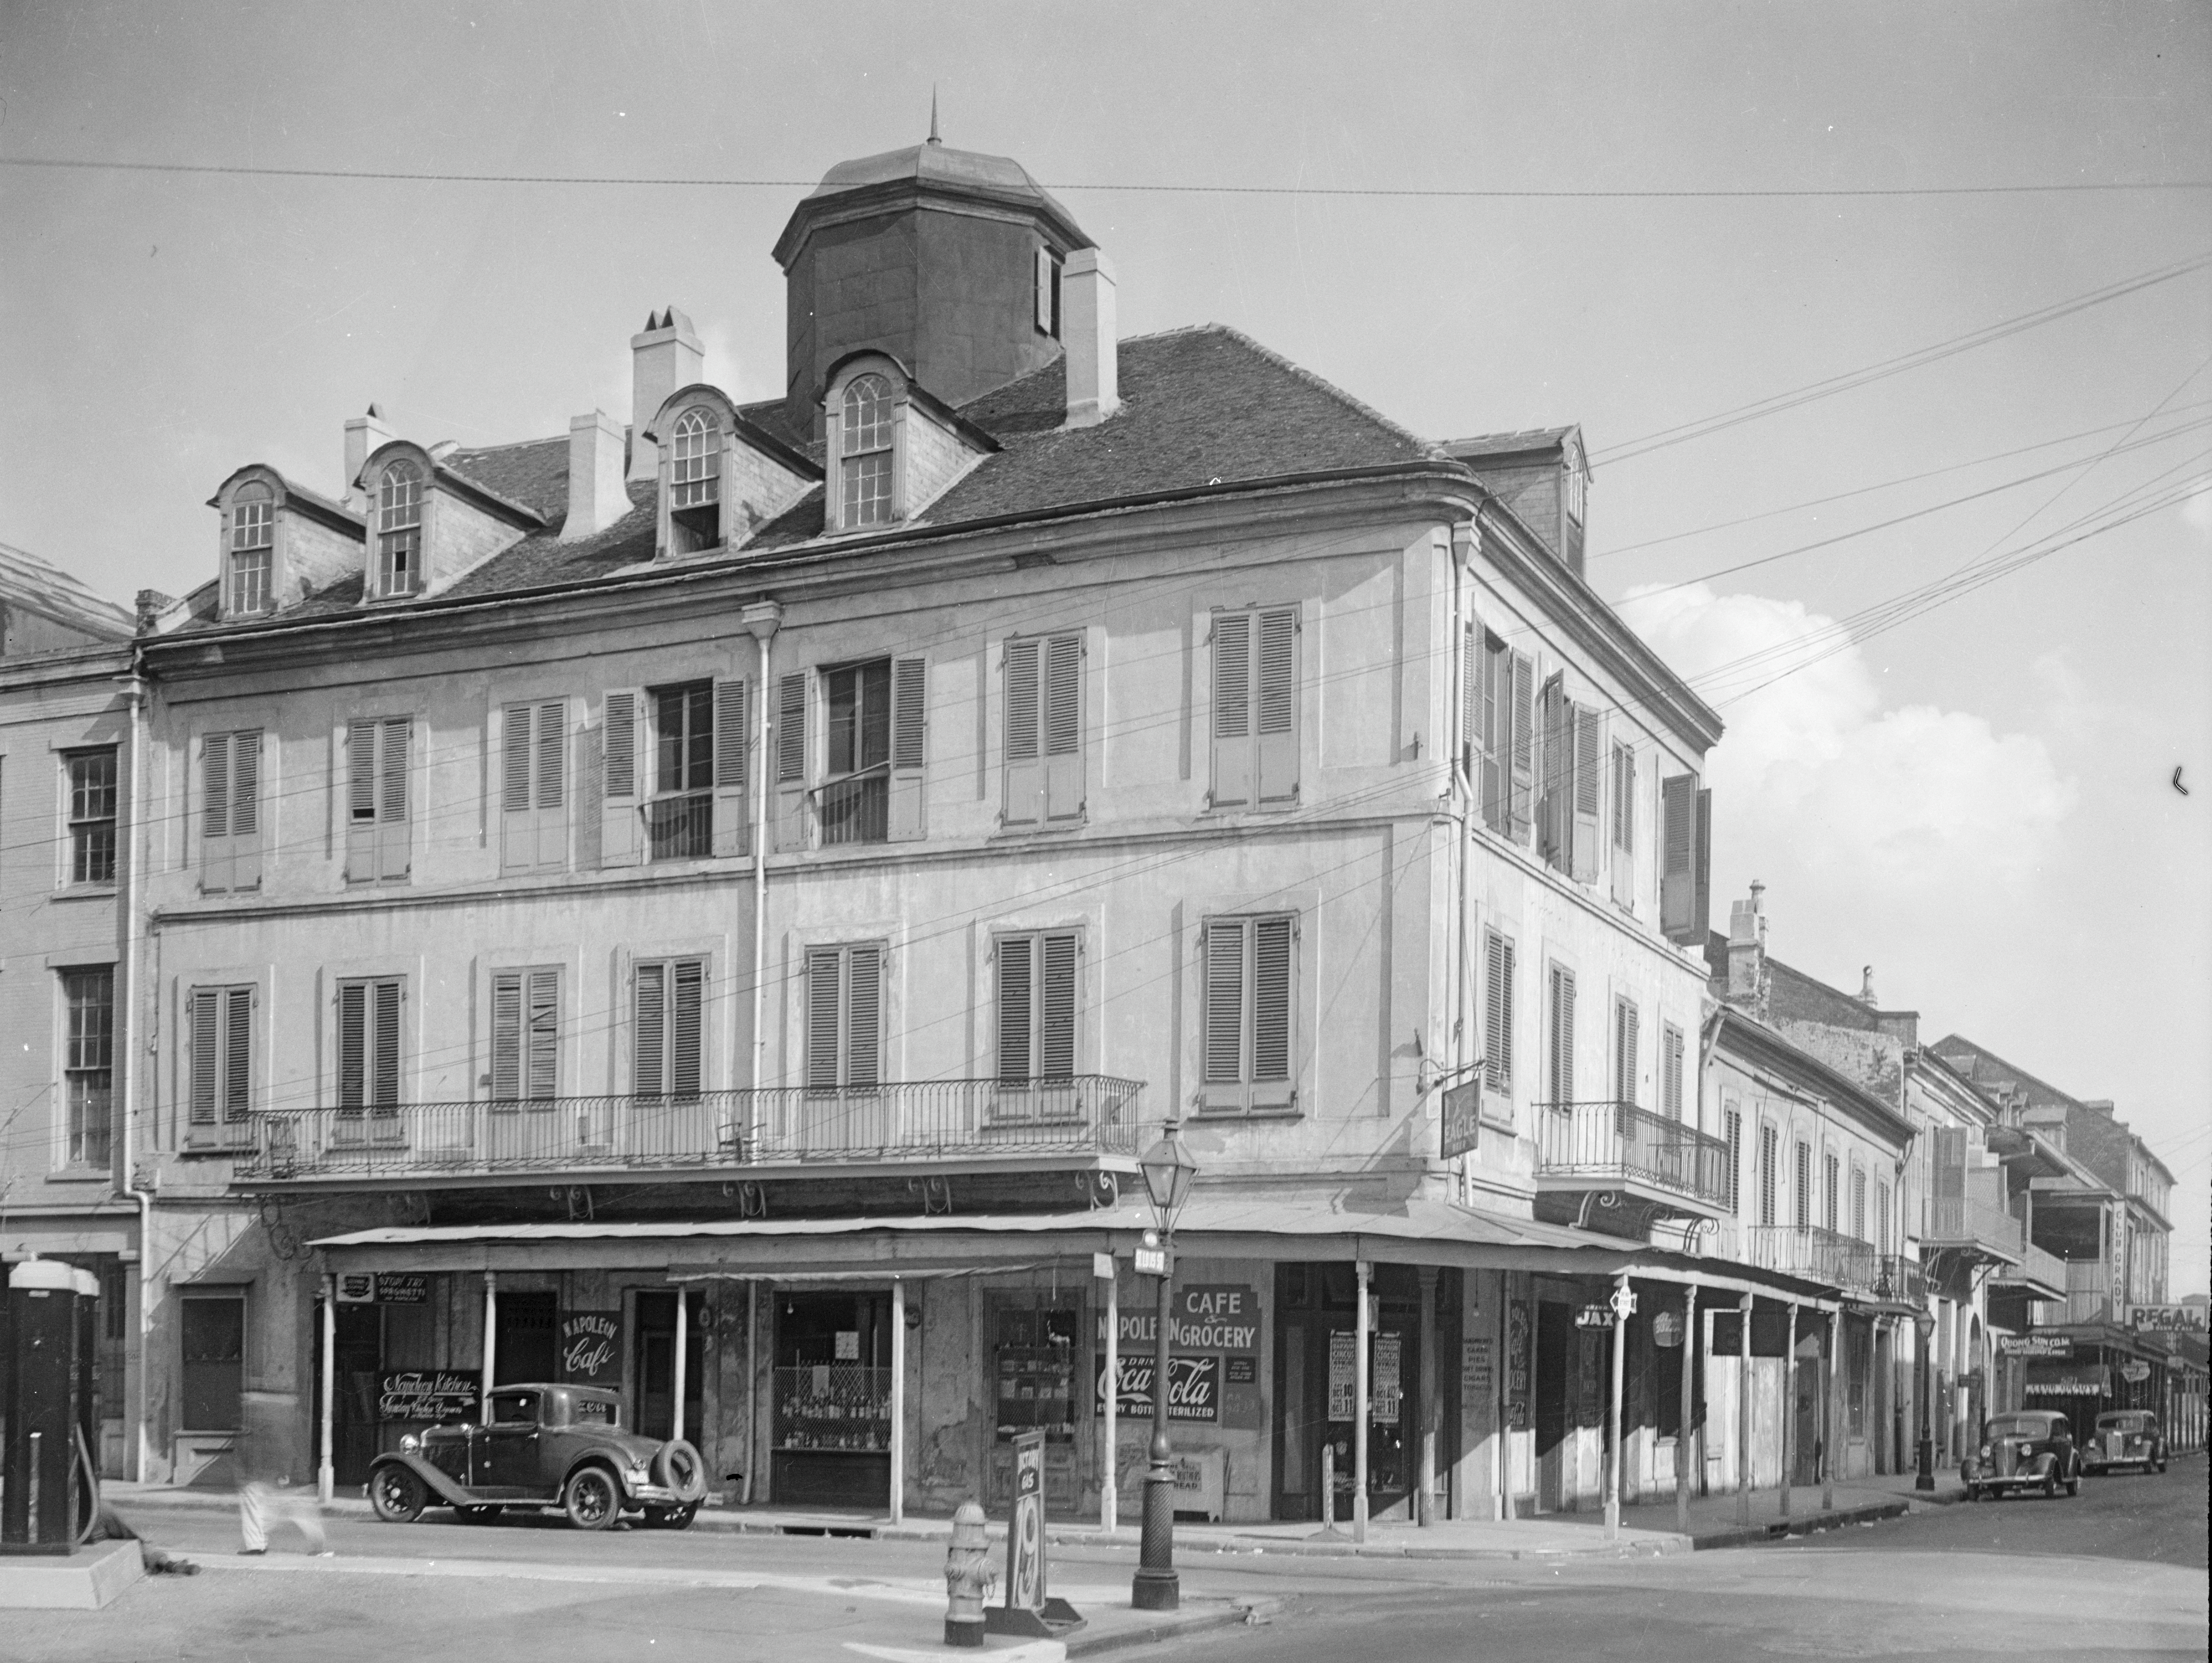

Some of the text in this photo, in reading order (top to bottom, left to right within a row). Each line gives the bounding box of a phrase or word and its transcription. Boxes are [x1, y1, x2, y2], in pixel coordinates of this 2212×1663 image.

[1445, 1115, 1476, 1144] EAGLE
[1186, 1292, 1241, 1314] CAFE
[1204, 1314, 1228, 1324] &
[1577, 1311, 1615, 1326] JAX
[2132, 1308, 2193, 1327] REGAL
[563, 1315, 618, 1340] NAPOLEON
[1097, 1316, 1180, 1341] NPOLEN
[1180, 1325, 1256, 1348] GROCERY
[2001, 1336, 2030, 1349] QUONG
[2032, 1335, 2048, 1346] SUN
[1129, 1357, 1155, 1366] DRIN
[434, 1372, 479, 1393] Kitchen
[1344, 1384, 1353, 1397] 10
[1097, 1403, 1127, 1413] ERY
[1169, 1406, 1214, 1417] TERILIZED
[1345, 1399, 1353, 1413] 11
[1388, 1400, 1396, 1414] 11
[1022, 1472, 1034, 1490] GAS
